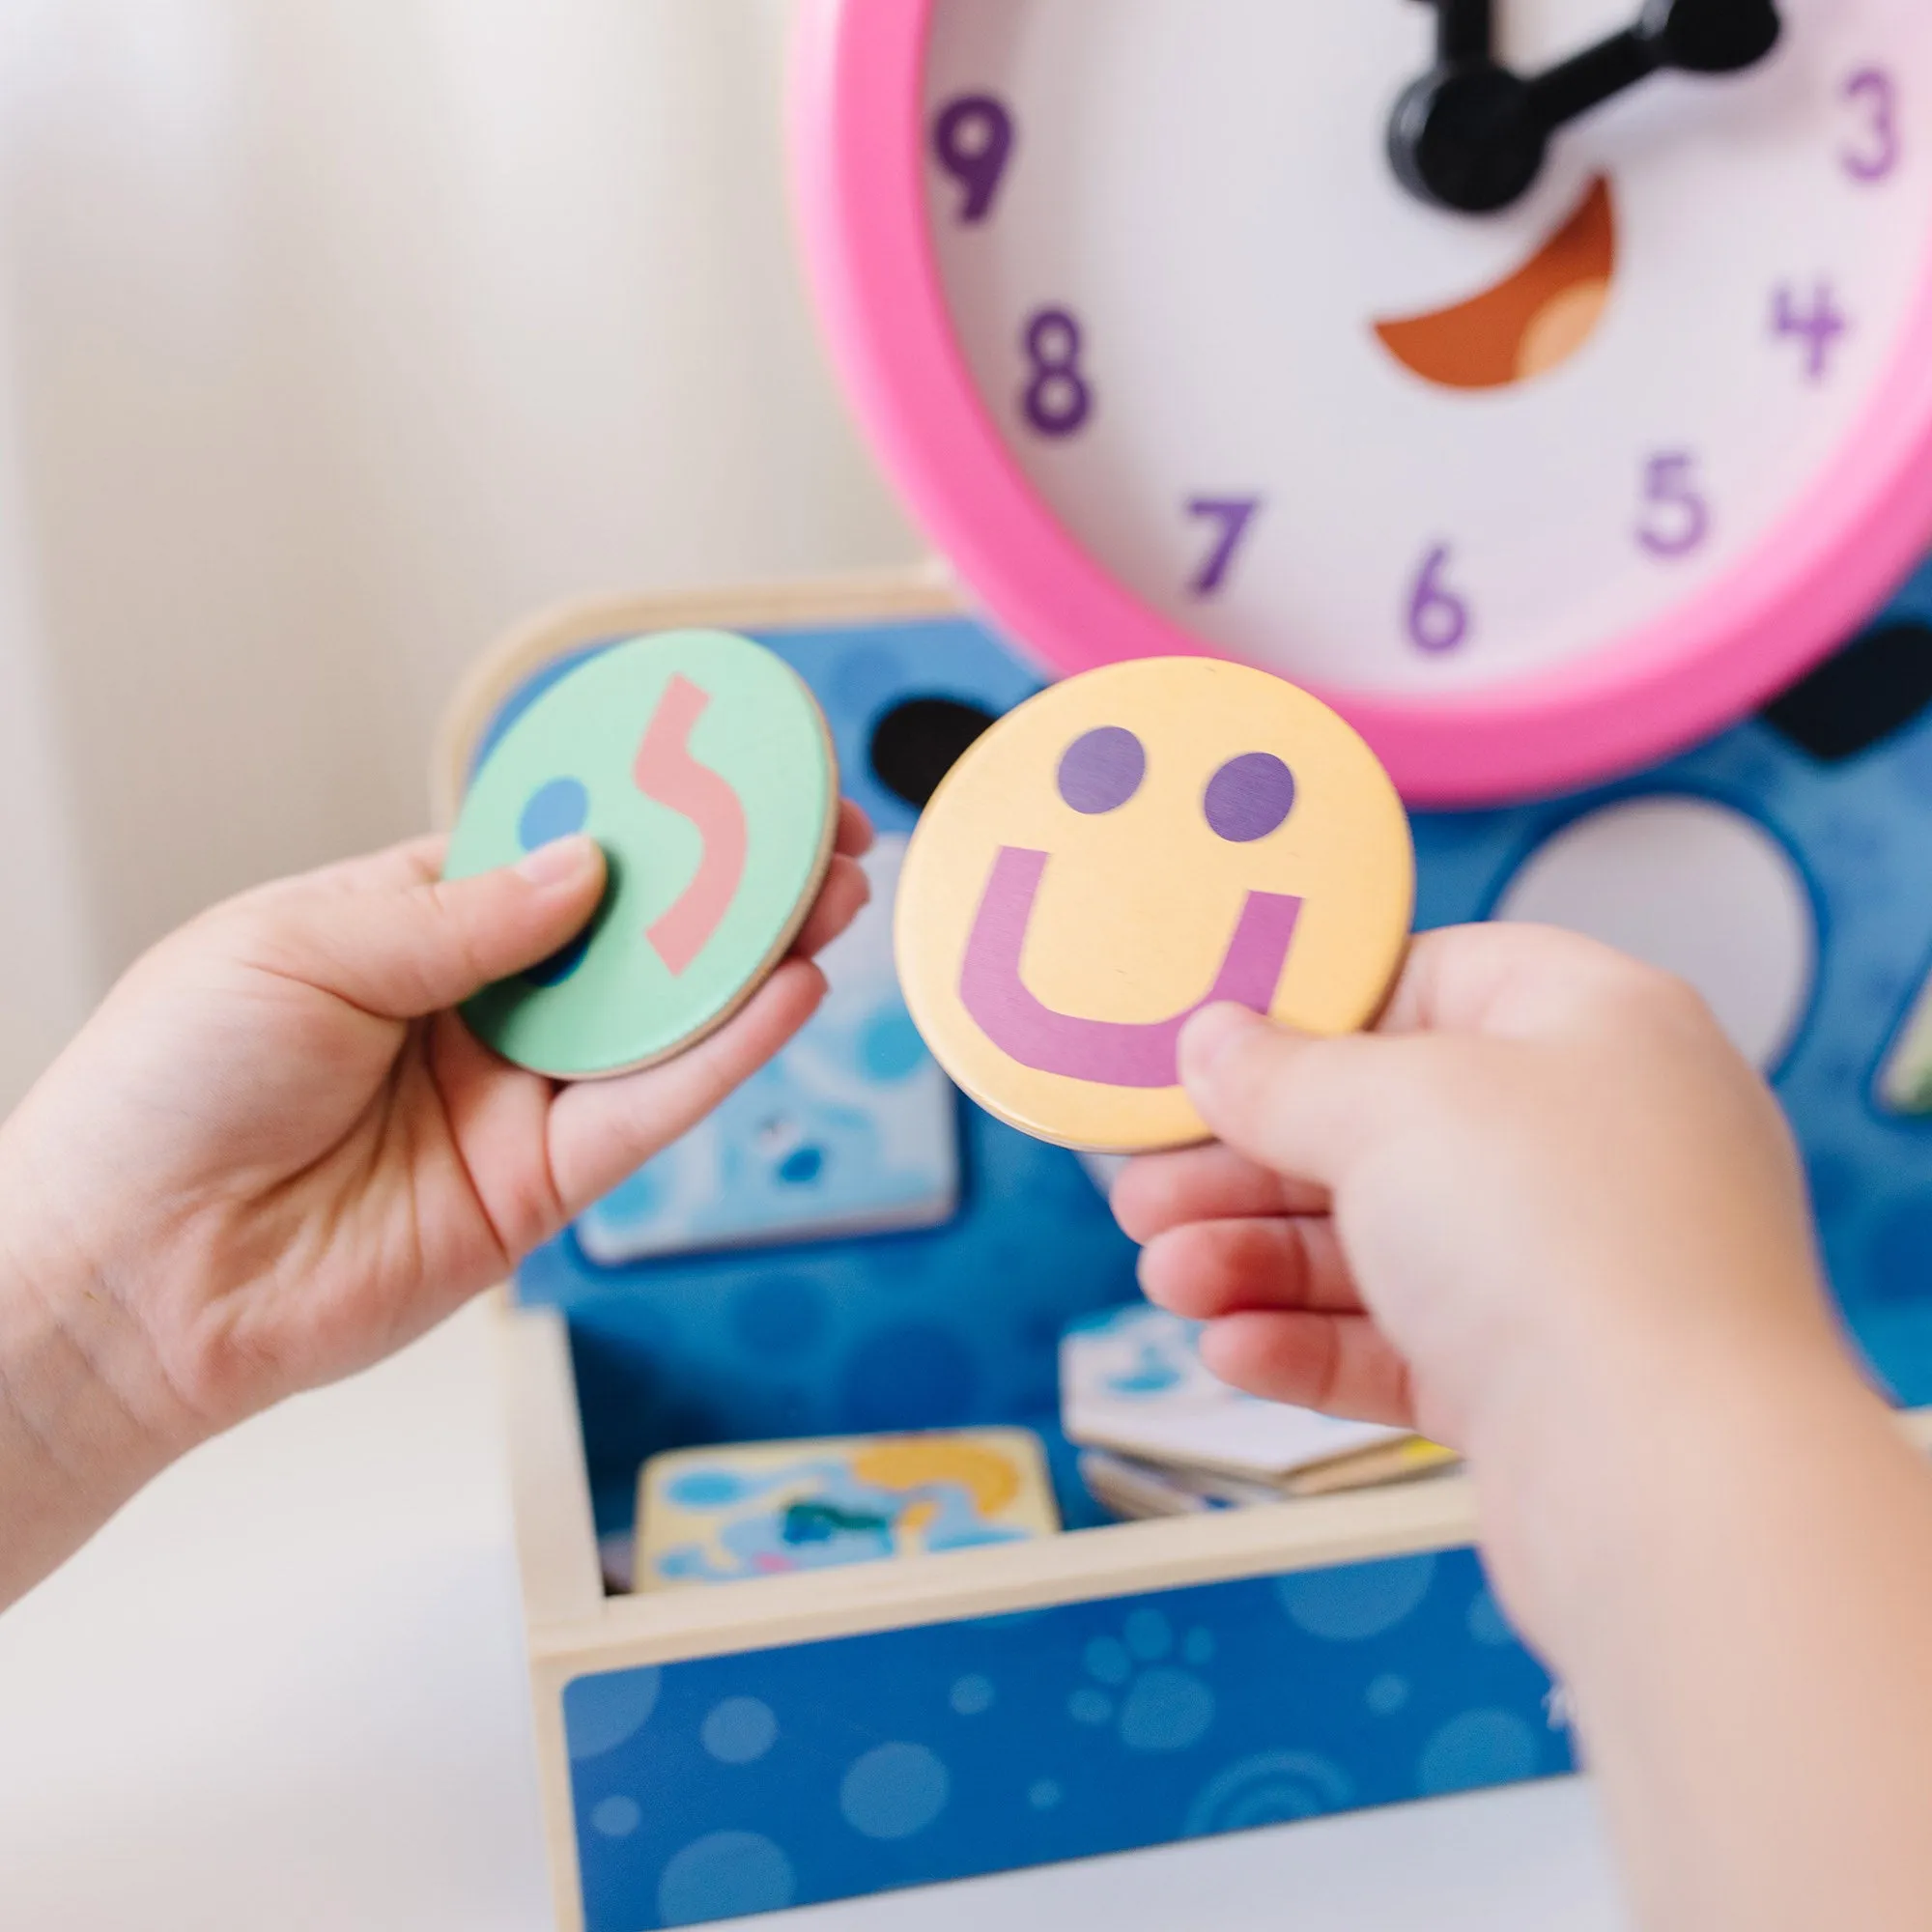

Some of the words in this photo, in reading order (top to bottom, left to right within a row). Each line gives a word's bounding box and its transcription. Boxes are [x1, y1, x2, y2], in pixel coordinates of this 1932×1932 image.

[932, 95, 1014, 225] 9
[1839, 71, 1898, 182] 3
[1021, 308, 1093, 438] 8
[1770, 279, 1847, 380] 4
[1184, 496, 1263, 597] 7
[1634, 451, 1709, 557] 5
[1406, 543, 1469, 655] 6
